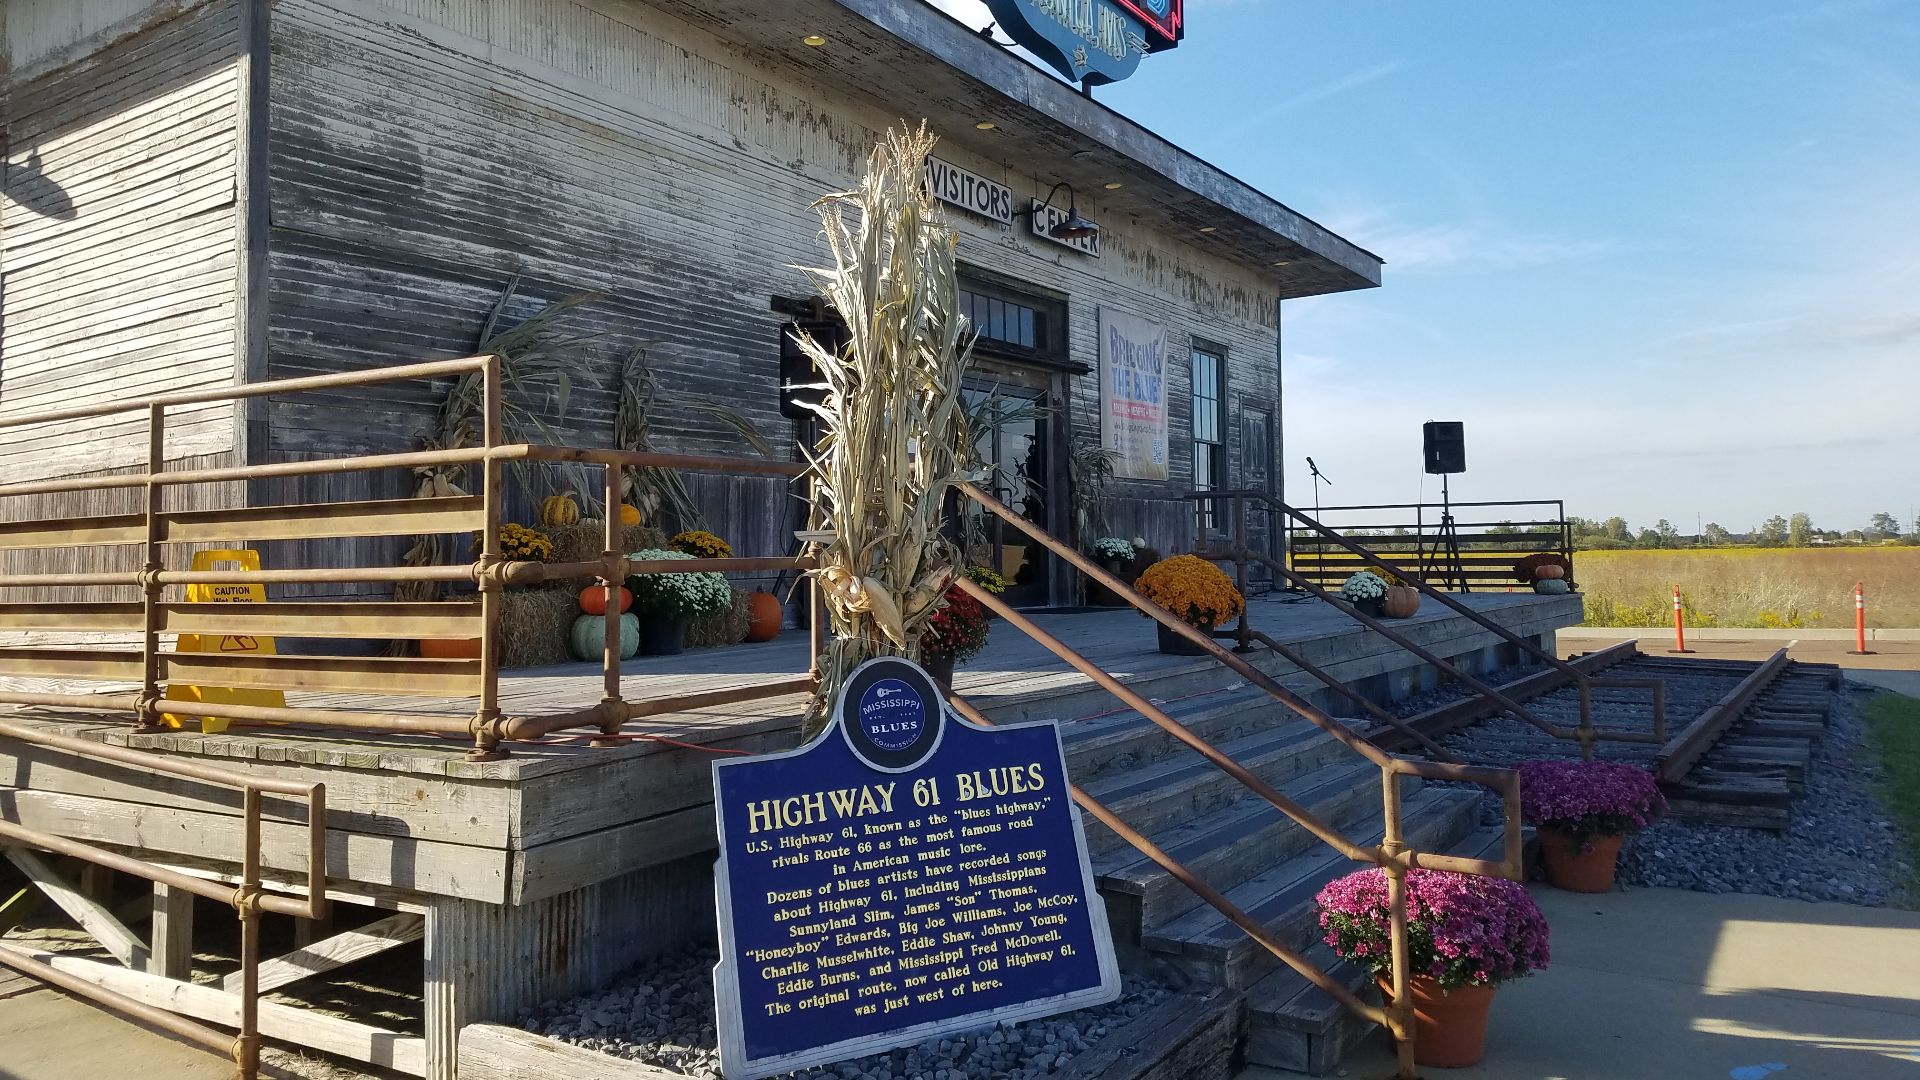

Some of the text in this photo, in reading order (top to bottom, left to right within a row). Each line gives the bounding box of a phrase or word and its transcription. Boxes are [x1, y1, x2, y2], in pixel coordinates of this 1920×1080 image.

[929, 159, 1010, 220] VISITORS
[214, 586, 250, 595] CAUTION
[863, 698, 920, 715] MISSISSIPPI
[871, 721, 918, 733] BLUES
[746, 763, 1045, 833] HIGHWAY 61 BLUES
[746, 840, 773, 854] U.S.
[780, 832, 833, 849] Highway
[842, 826, 857, 838] 61,
[864, 821, 903, 835] known
[908, 819, 921, 828] as
[928, 814, 948, 825] the
[954, 808, 991, 820] “blues
[772, 816, 1033, 868] rivals Route 66 as the most famous road
[767, 849, 1047, 904] Dozens of blues artists have recorded songs
[833, 843, 987, 876] in American music lore.
[774, 865, 1047, 922] about Highway 61, including Mississippians
[789, 914, 857, 937] Sunnyland
[864, 910, 895, 923] Slim,
[904, 901, 941, 916] James
[989, 885, 1038, 900] Thomas,
[836, 927, 891, 946] Edwards,
[899, 922, 919, 935] Big
[925, 917, 946, 930] Joe
[952, 907, 1006, 924] Williams,
[1013, 900, 1032, 913] Joe
[1038, 892, 1078, 909] McCoy,
[762, 913, 1068, 980] Charlie Musselwhite, Eddie Shaw, Johnny Young,
[778, 929, 1061, 995] Eddie Burns, and Mississippi Fred McDowell.
[765, 944, 1076, 1017] The original route, now called Old Highway 61,
[855, 979, 1003, 1017] was just west of here.
